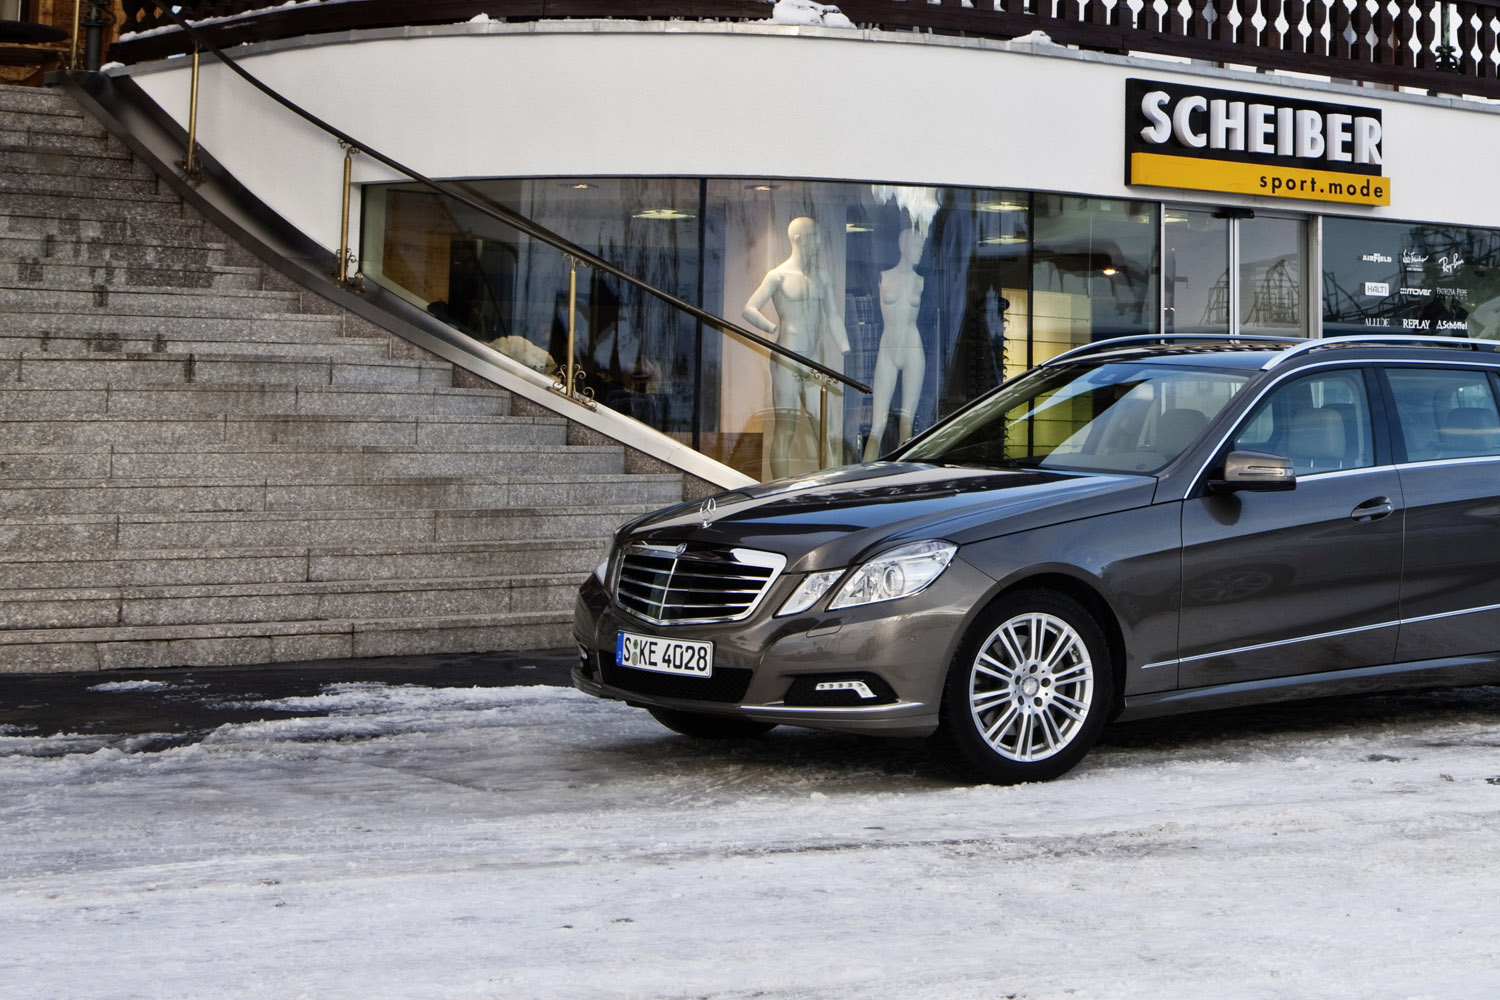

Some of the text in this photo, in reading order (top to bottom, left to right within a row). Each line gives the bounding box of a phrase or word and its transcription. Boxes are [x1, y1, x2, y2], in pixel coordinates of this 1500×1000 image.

[1140, 90, 1382, 165] SCHEIBER
[1259, 173, 1384, 198] sport.mode
[1367, 284, 1387, 294] HALTI
[1402, 318, 1430, 329] REPLAY
[662, 643, 708, 672] 4028
